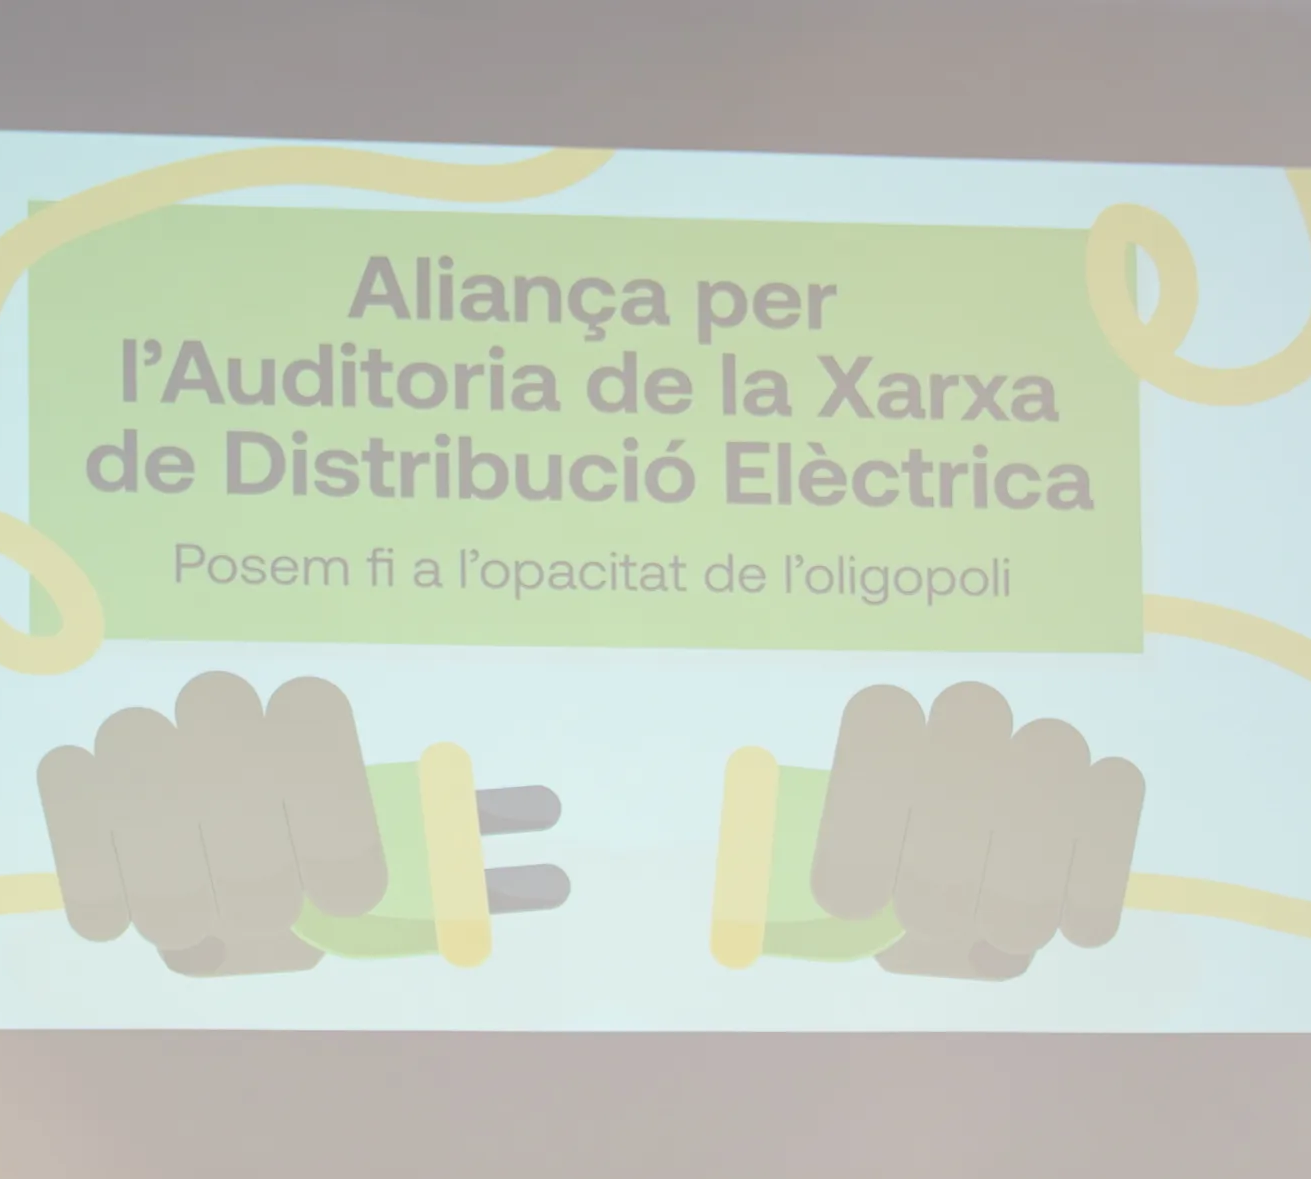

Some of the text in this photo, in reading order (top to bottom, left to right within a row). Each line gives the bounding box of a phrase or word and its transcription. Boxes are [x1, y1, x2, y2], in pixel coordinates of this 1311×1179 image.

[346, 254, 838, 345] Aliança per
[122, 337, 1060, 423] l'Auditoria de la Xarxa
[85, 428, 1096, 511] de Distribució Elèctrica
[174, 542, 1011, 607] Posem fi a l'opacitat de l'oligopoli
